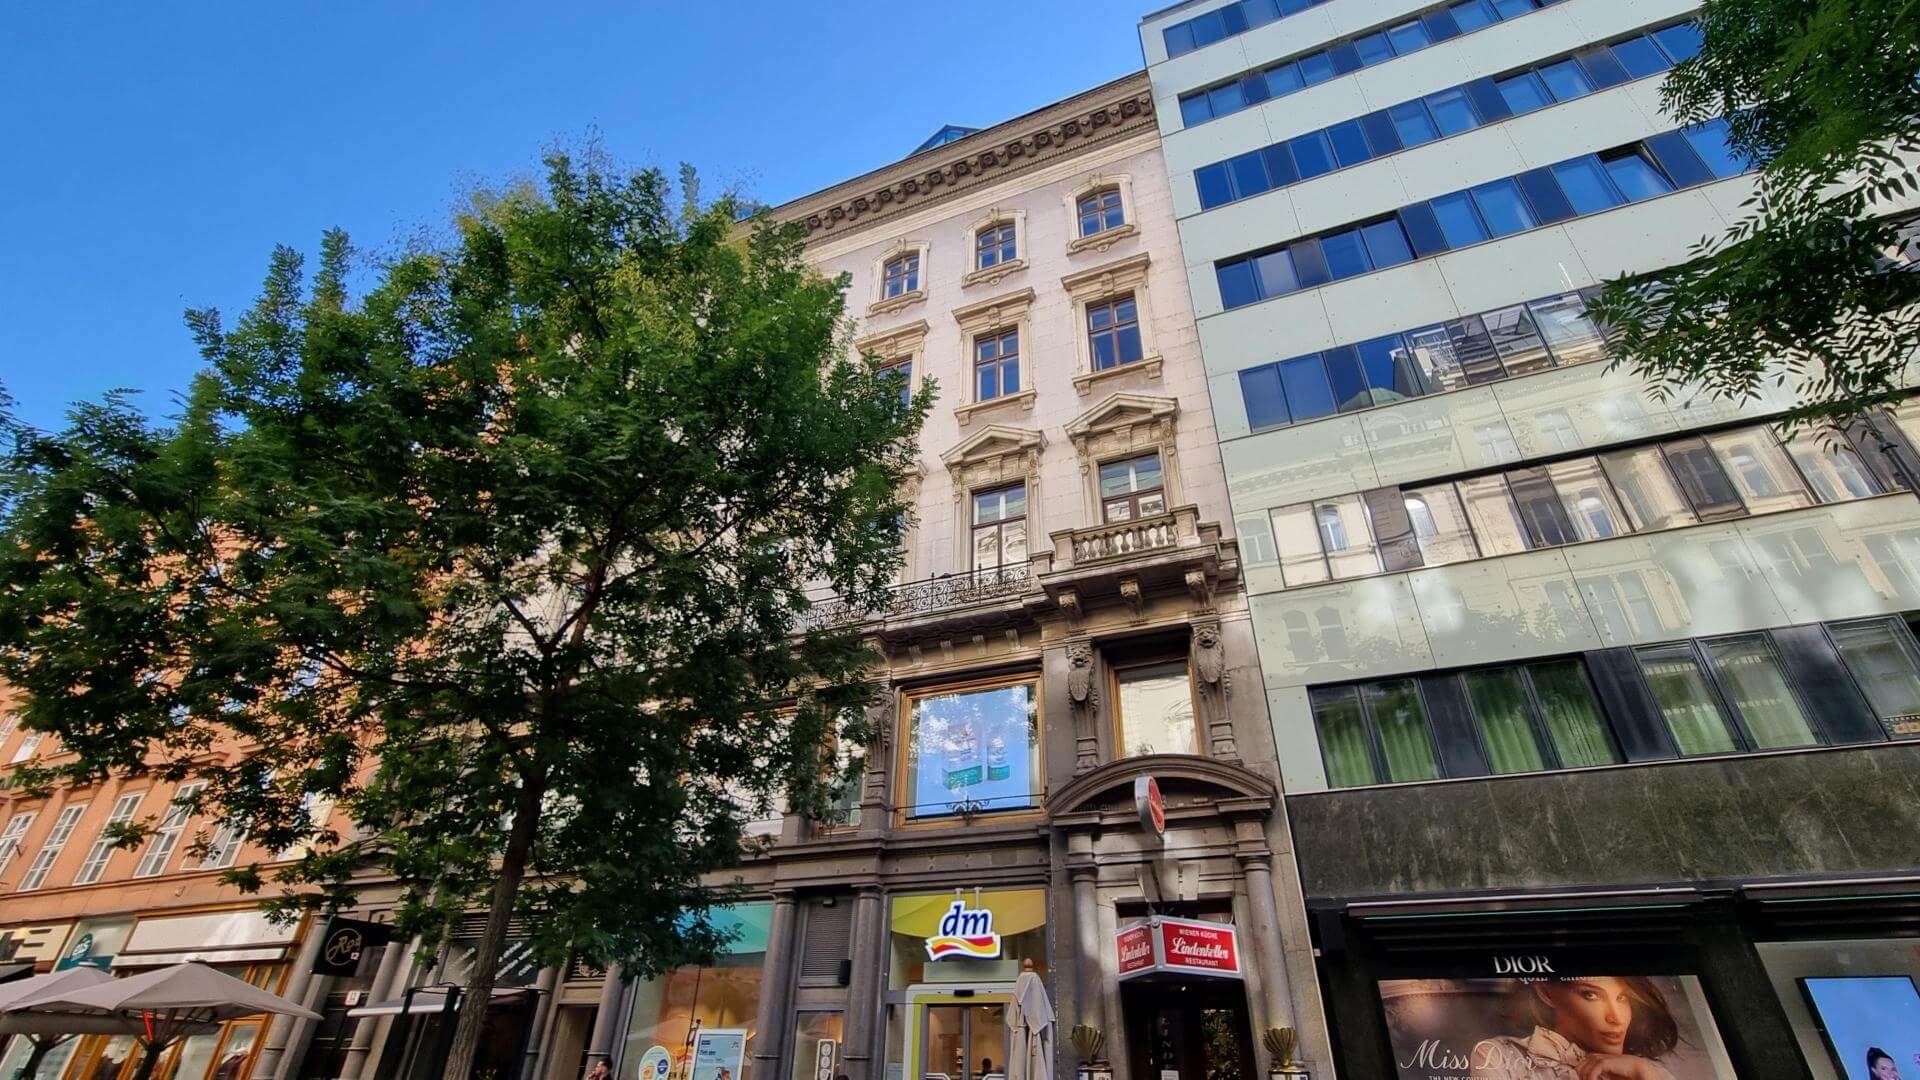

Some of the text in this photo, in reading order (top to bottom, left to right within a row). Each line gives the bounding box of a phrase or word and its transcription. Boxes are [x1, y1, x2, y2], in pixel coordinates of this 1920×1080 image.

[942, 904, 989, 936] dm
[1170, 936, 1229, 960] Lindenkeller
[1185, 957, 1219, 967] RESTAURANT
[1493, 956, 1555, 974] DIOR
[1400, 1039, 1469, 1070] Miss
